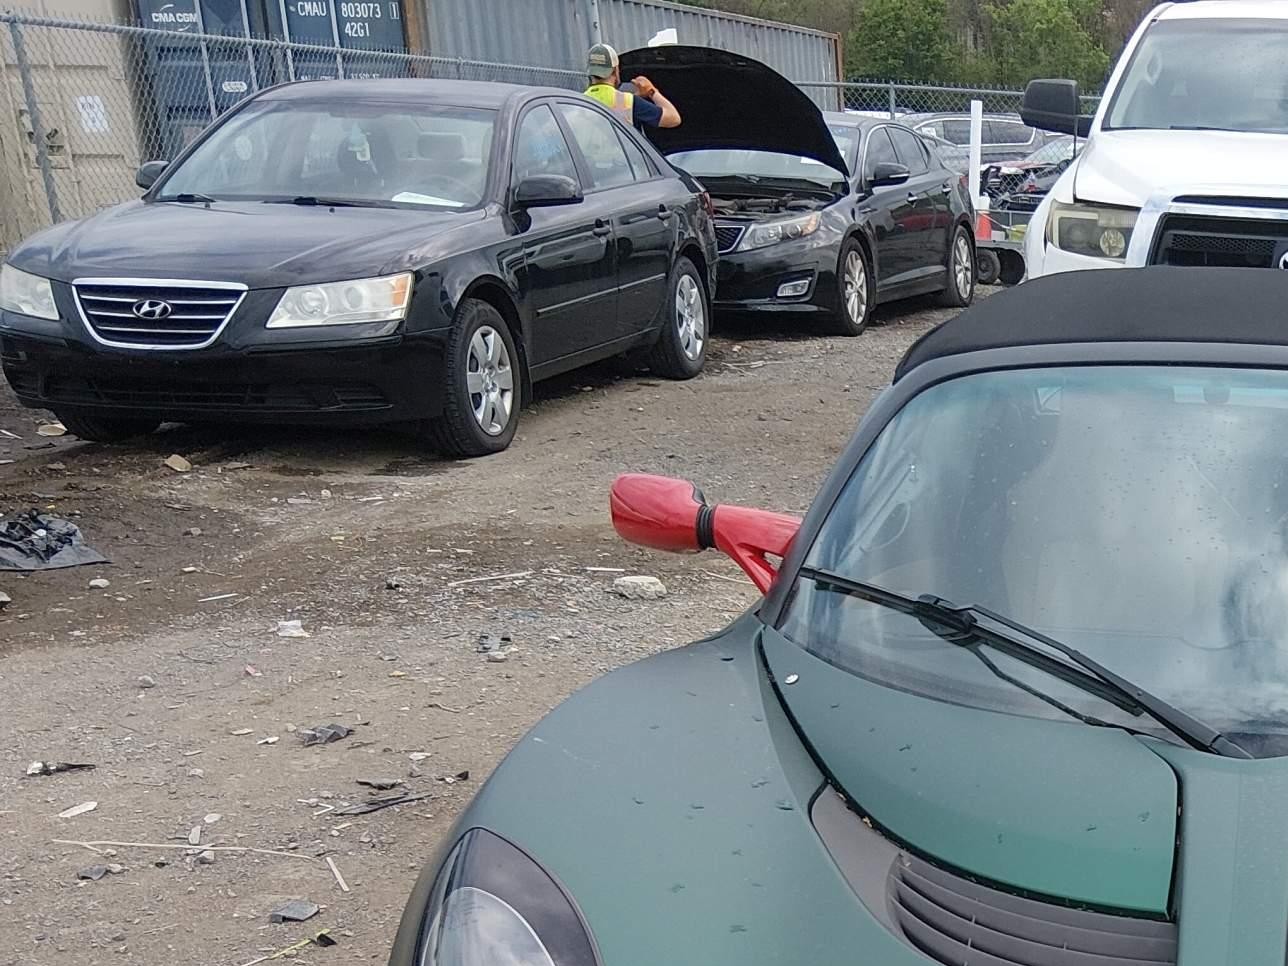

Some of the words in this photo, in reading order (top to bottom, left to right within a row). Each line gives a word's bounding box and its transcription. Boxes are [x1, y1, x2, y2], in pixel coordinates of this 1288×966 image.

[152, 12, 176, 23] CMA
[176, 12, 198, 23] CGM
[298, 2, 327, 17] CMAU
[341, 3, 381, 18] 803073
[344, 22, 370, 37] 42G1
